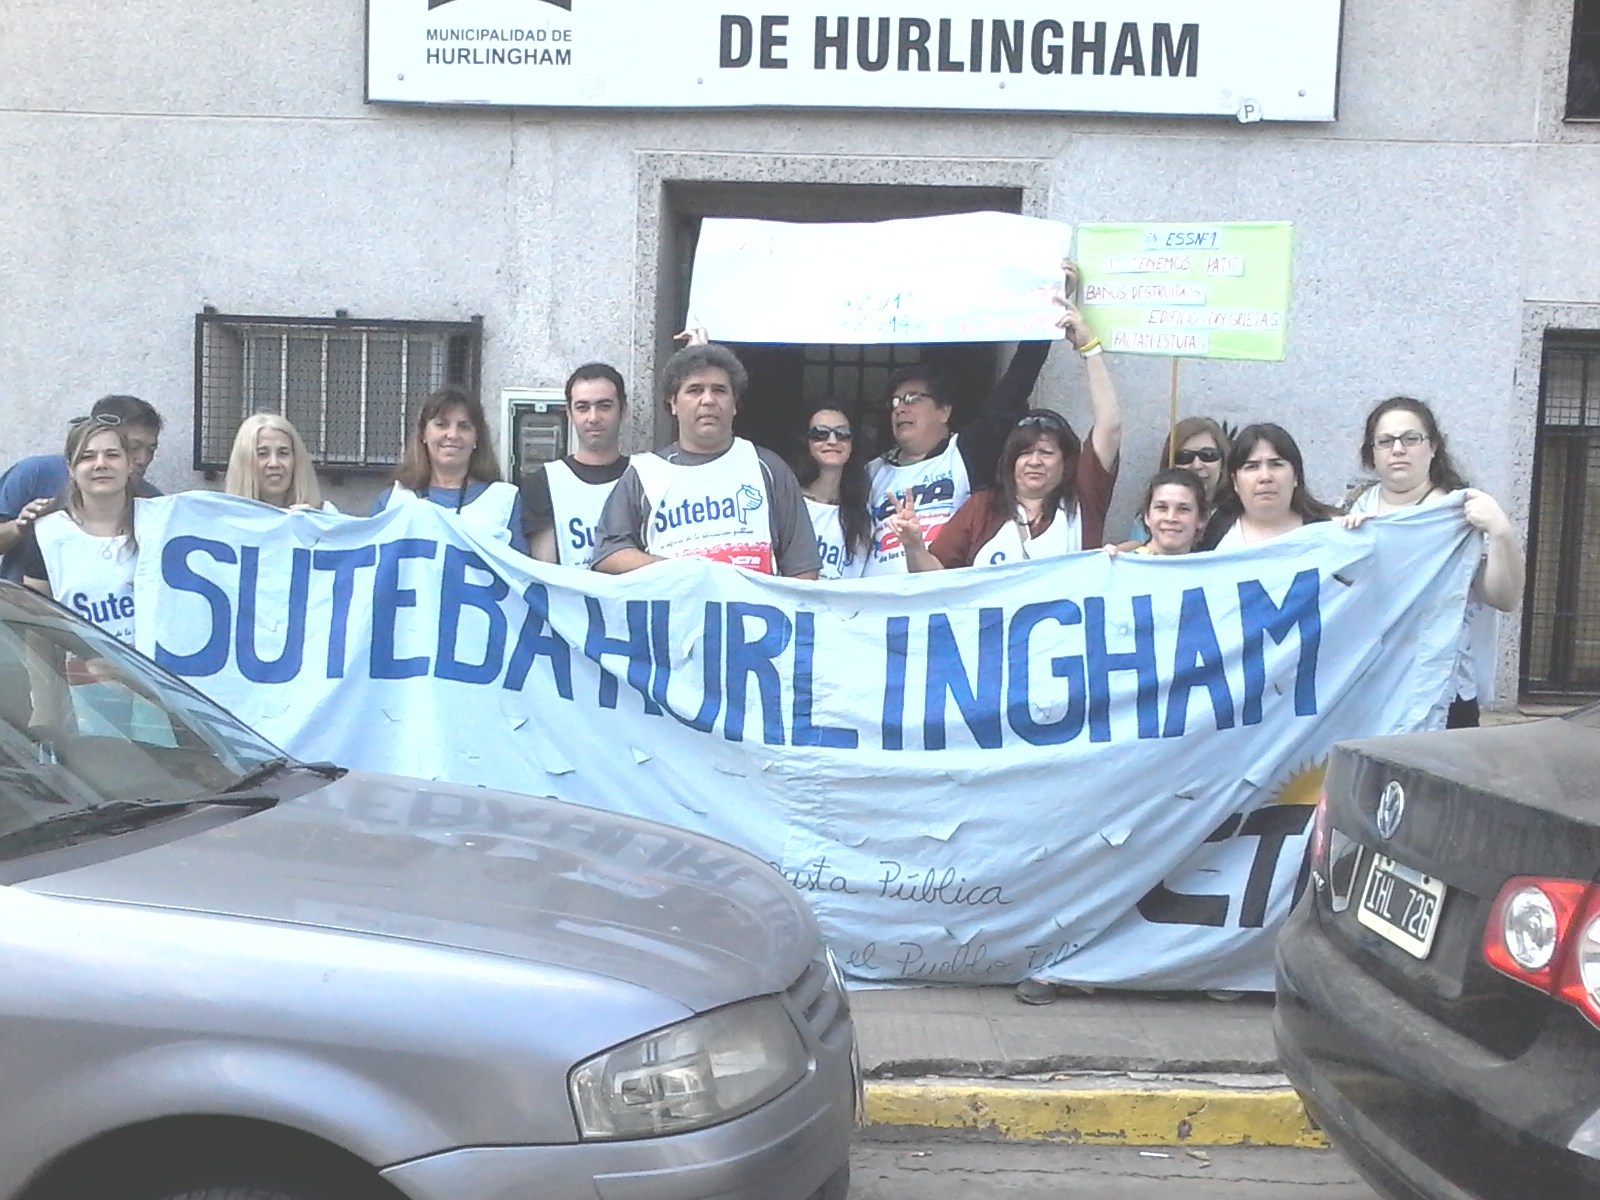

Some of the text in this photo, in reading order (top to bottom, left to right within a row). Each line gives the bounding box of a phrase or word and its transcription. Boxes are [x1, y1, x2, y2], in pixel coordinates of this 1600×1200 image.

[426, 28, 573, 42] MUNICIPALIDAD DE
[426, 47, 572, 66] HURLINGHAM
[719, 14, 1200, 78] DE HURLINGHAM
[654, 495, 736, 533] Suteba
[154, 534, 1323, 751] SUTEBA HURLINGHAM
[769, 855, 1013, 906] usta Pública
[1136, 803, 1317, 929] CT
[1366, 870, 1435, 939] IHL 726
[846, 942, 879, 970] el
